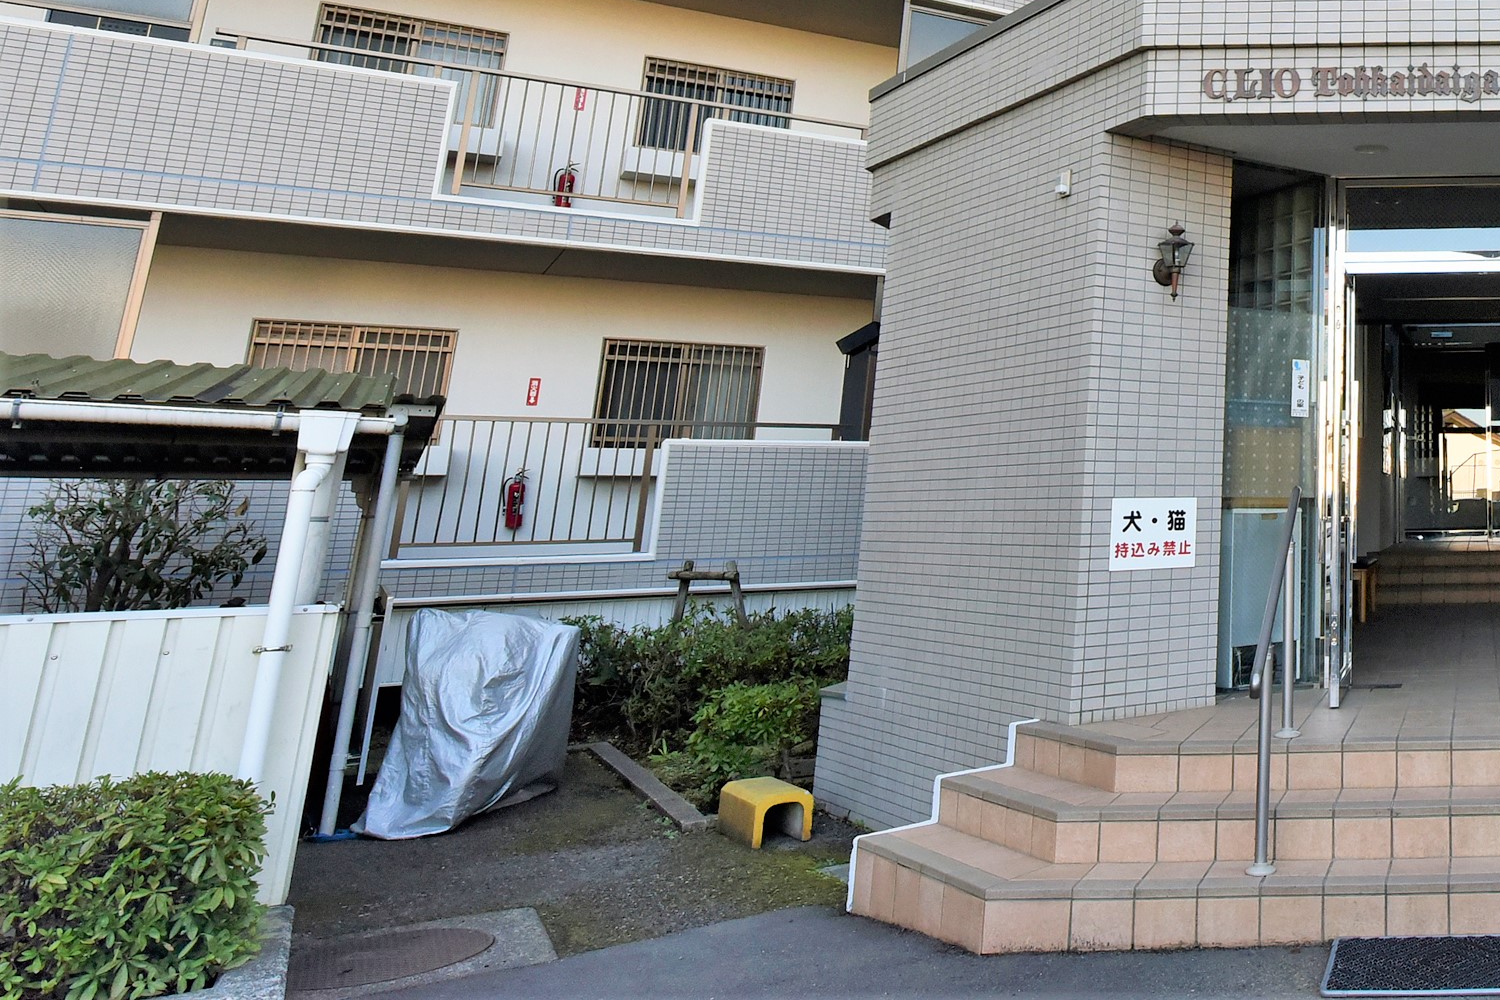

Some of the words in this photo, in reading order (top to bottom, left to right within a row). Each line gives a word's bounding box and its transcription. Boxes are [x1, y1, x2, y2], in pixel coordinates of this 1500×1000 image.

[1203, 67, 1300, 102] CLIO
[1122, 510, 1186, 532] 犬・猫
[1115, 540, 1191, 558] 持込み禁止
